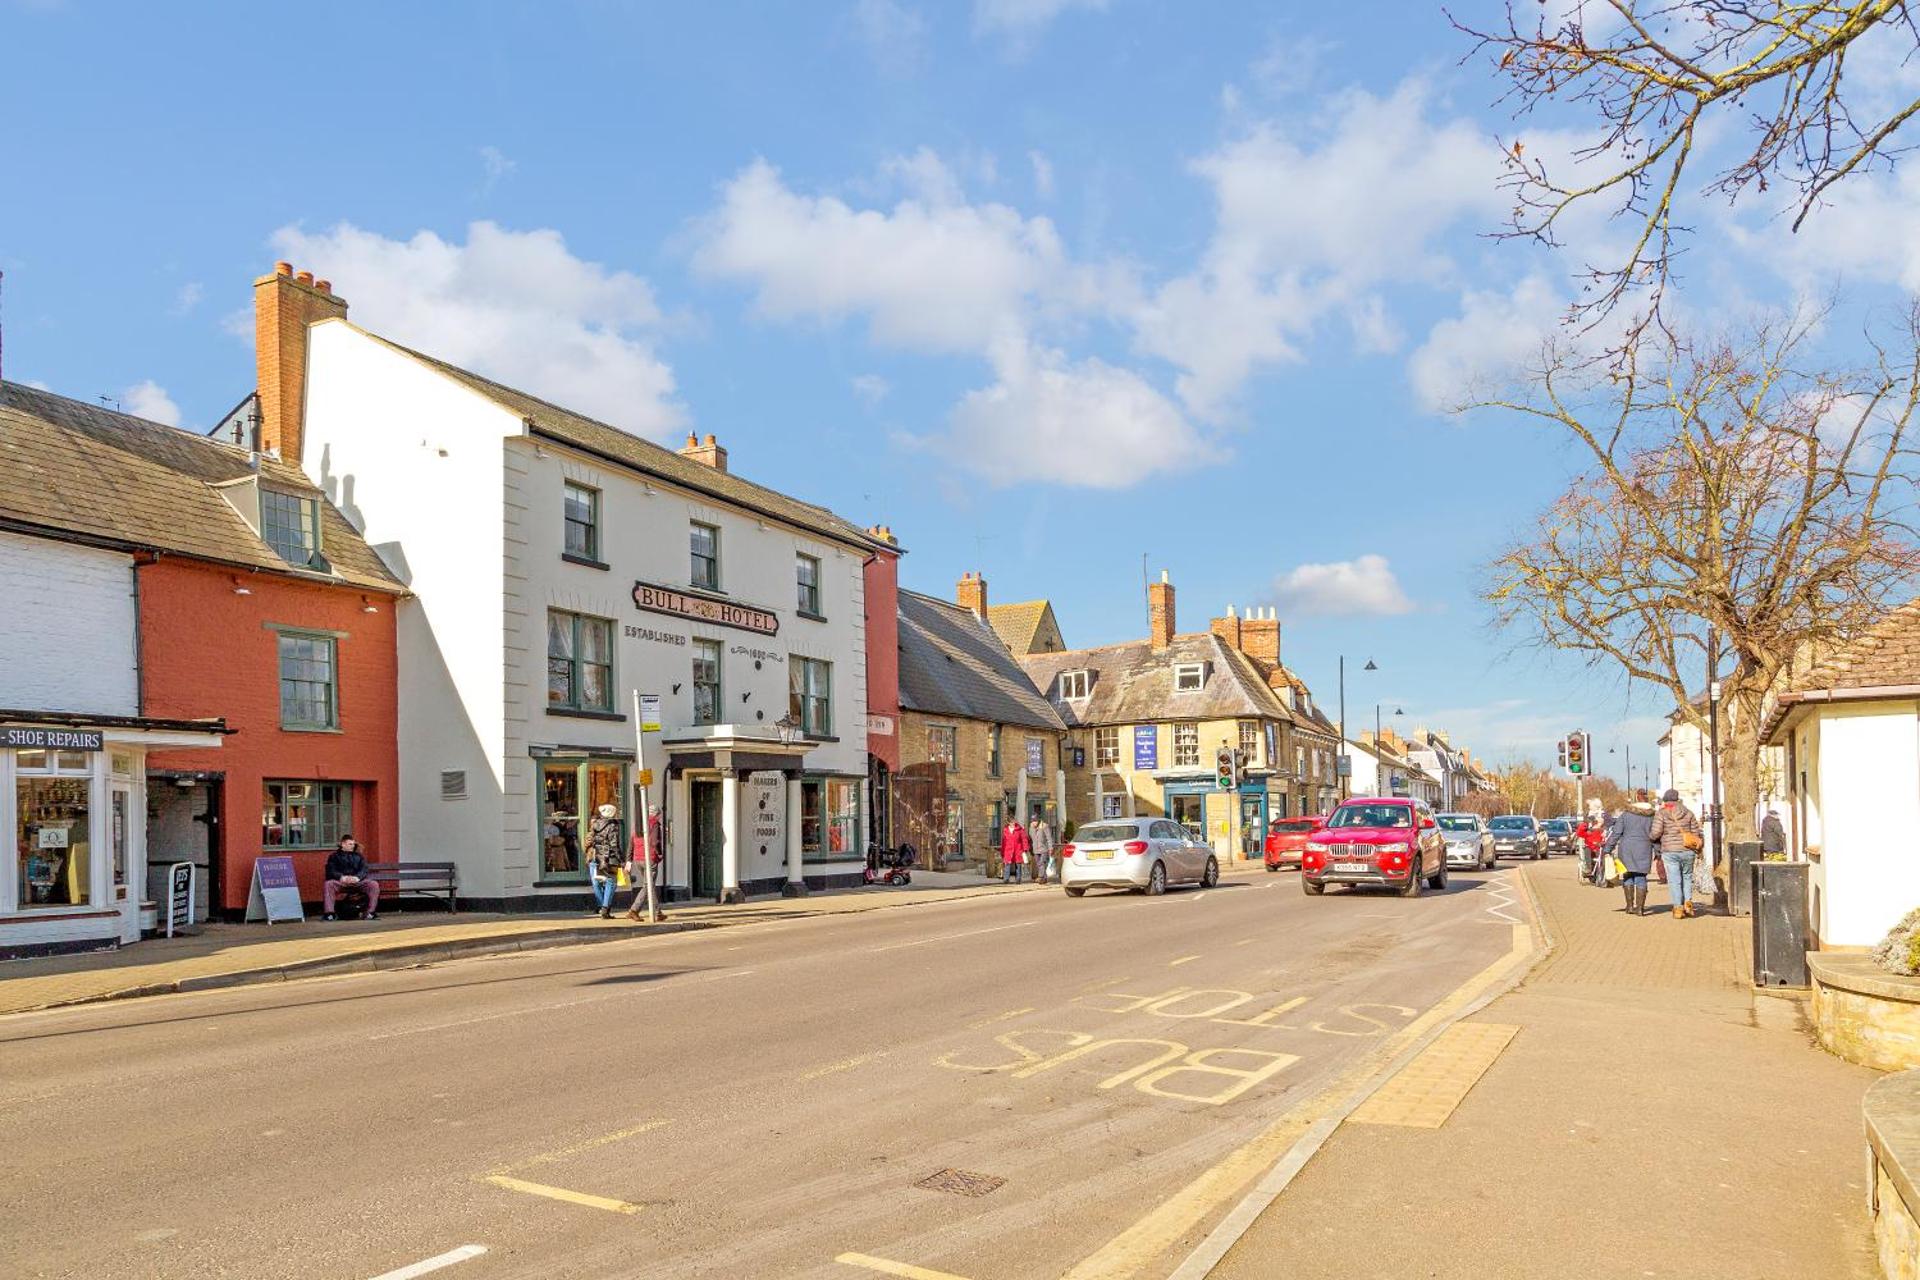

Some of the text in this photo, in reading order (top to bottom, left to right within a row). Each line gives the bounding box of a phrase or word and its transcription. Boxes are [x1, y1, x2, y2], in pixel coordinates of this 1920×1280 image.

[642, 588, 773, 631] BULL HOTEL
[624, 625, 687, 647] ESTABLISHED
[8, 730, 44, 745] SHOE
[47, 732, 100, 748] REPAIRS
[756, 827, 777, 837] FOODS
[1074, 984, 1418, 1037] STOP
[931, 1030, 1302, 1106] BUS
